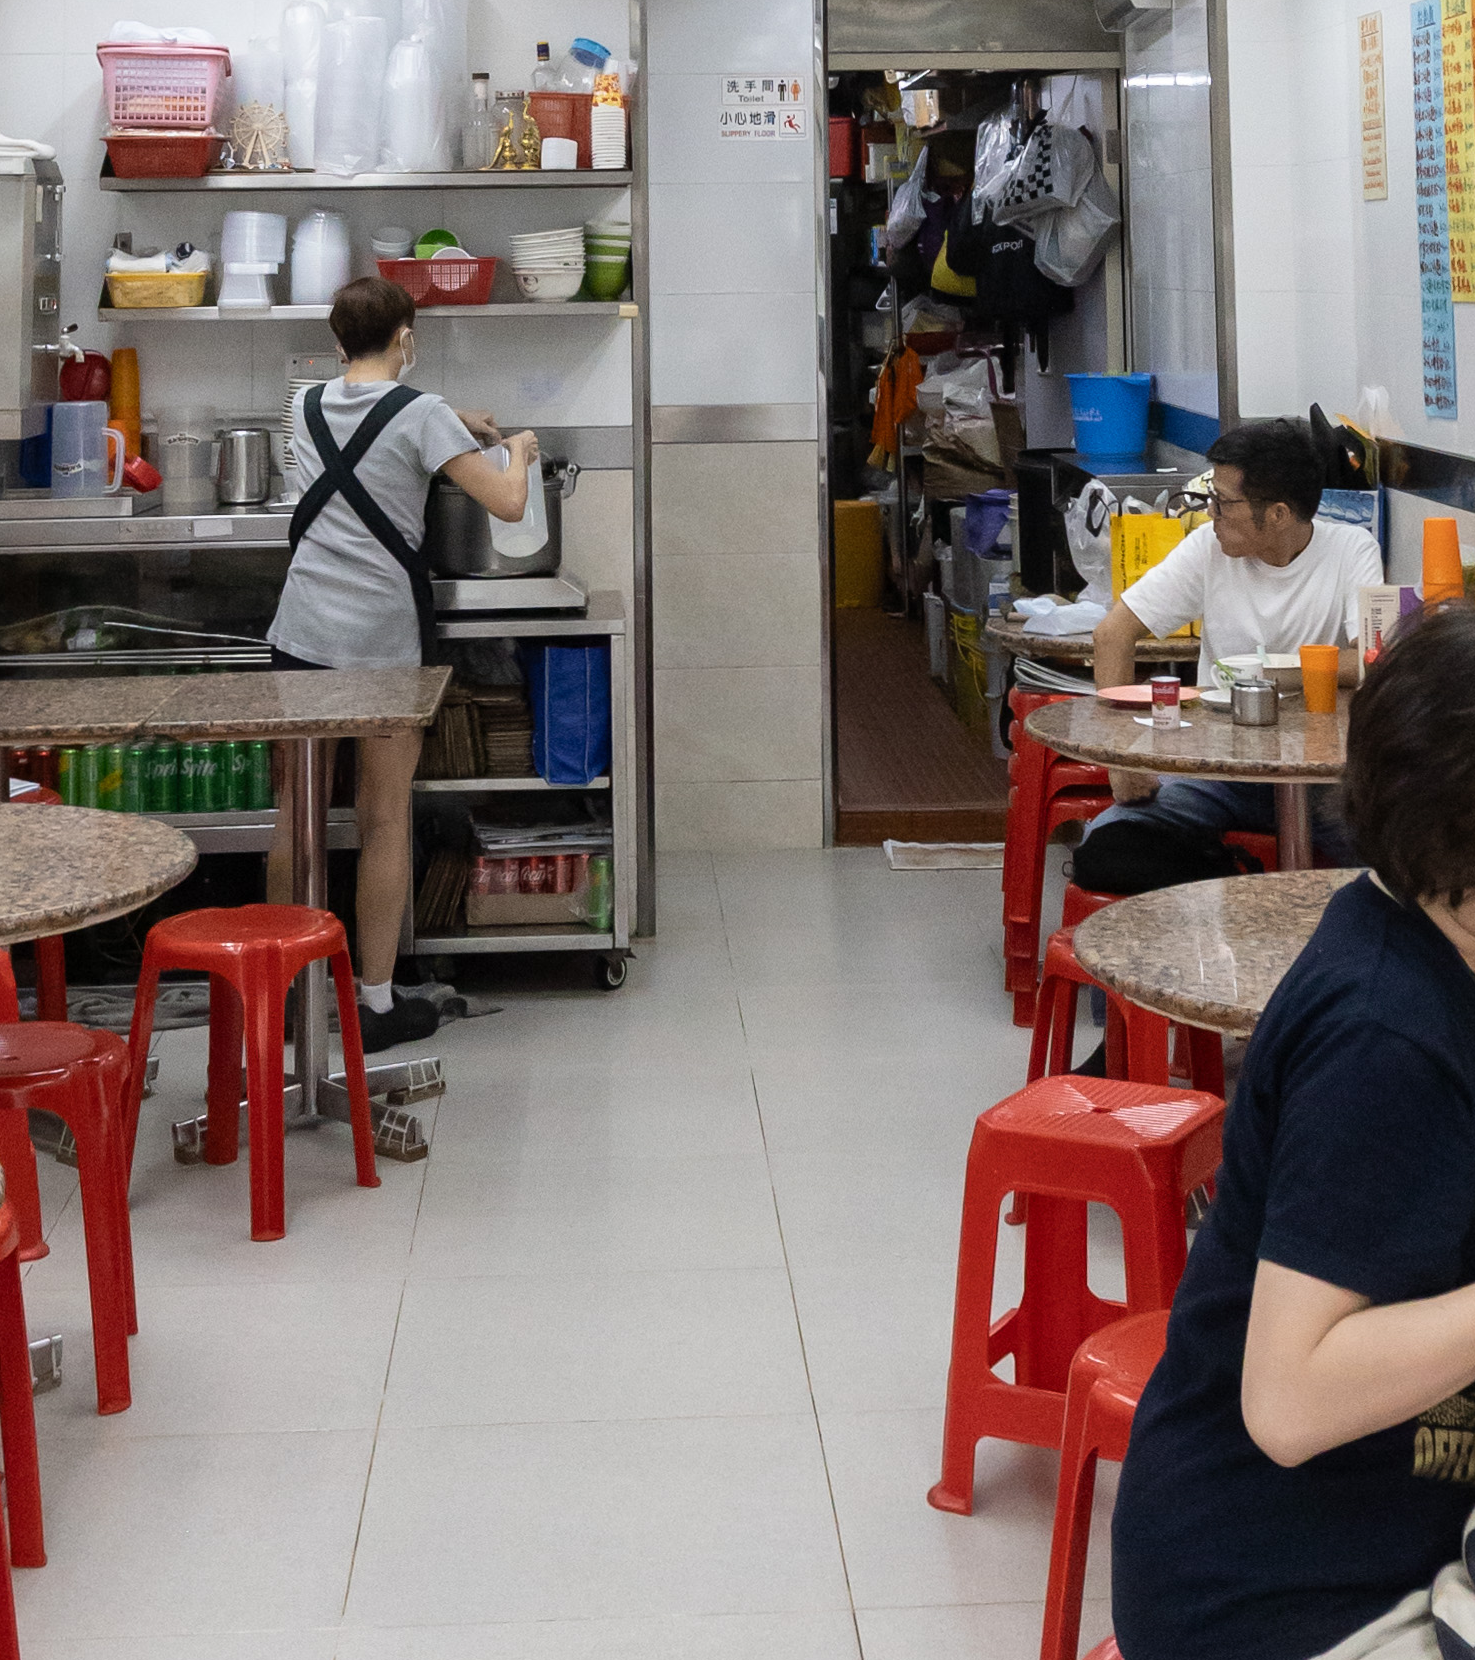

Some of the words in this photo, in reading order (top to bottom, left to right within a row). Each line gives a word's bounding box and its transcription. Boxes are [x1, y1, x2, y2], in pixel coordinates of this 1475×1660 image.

[727, 80, 773, 93] 洗手間
[720, 111, 776, 125] 小心地滑
[181, 757, 218, 777] Sprite
